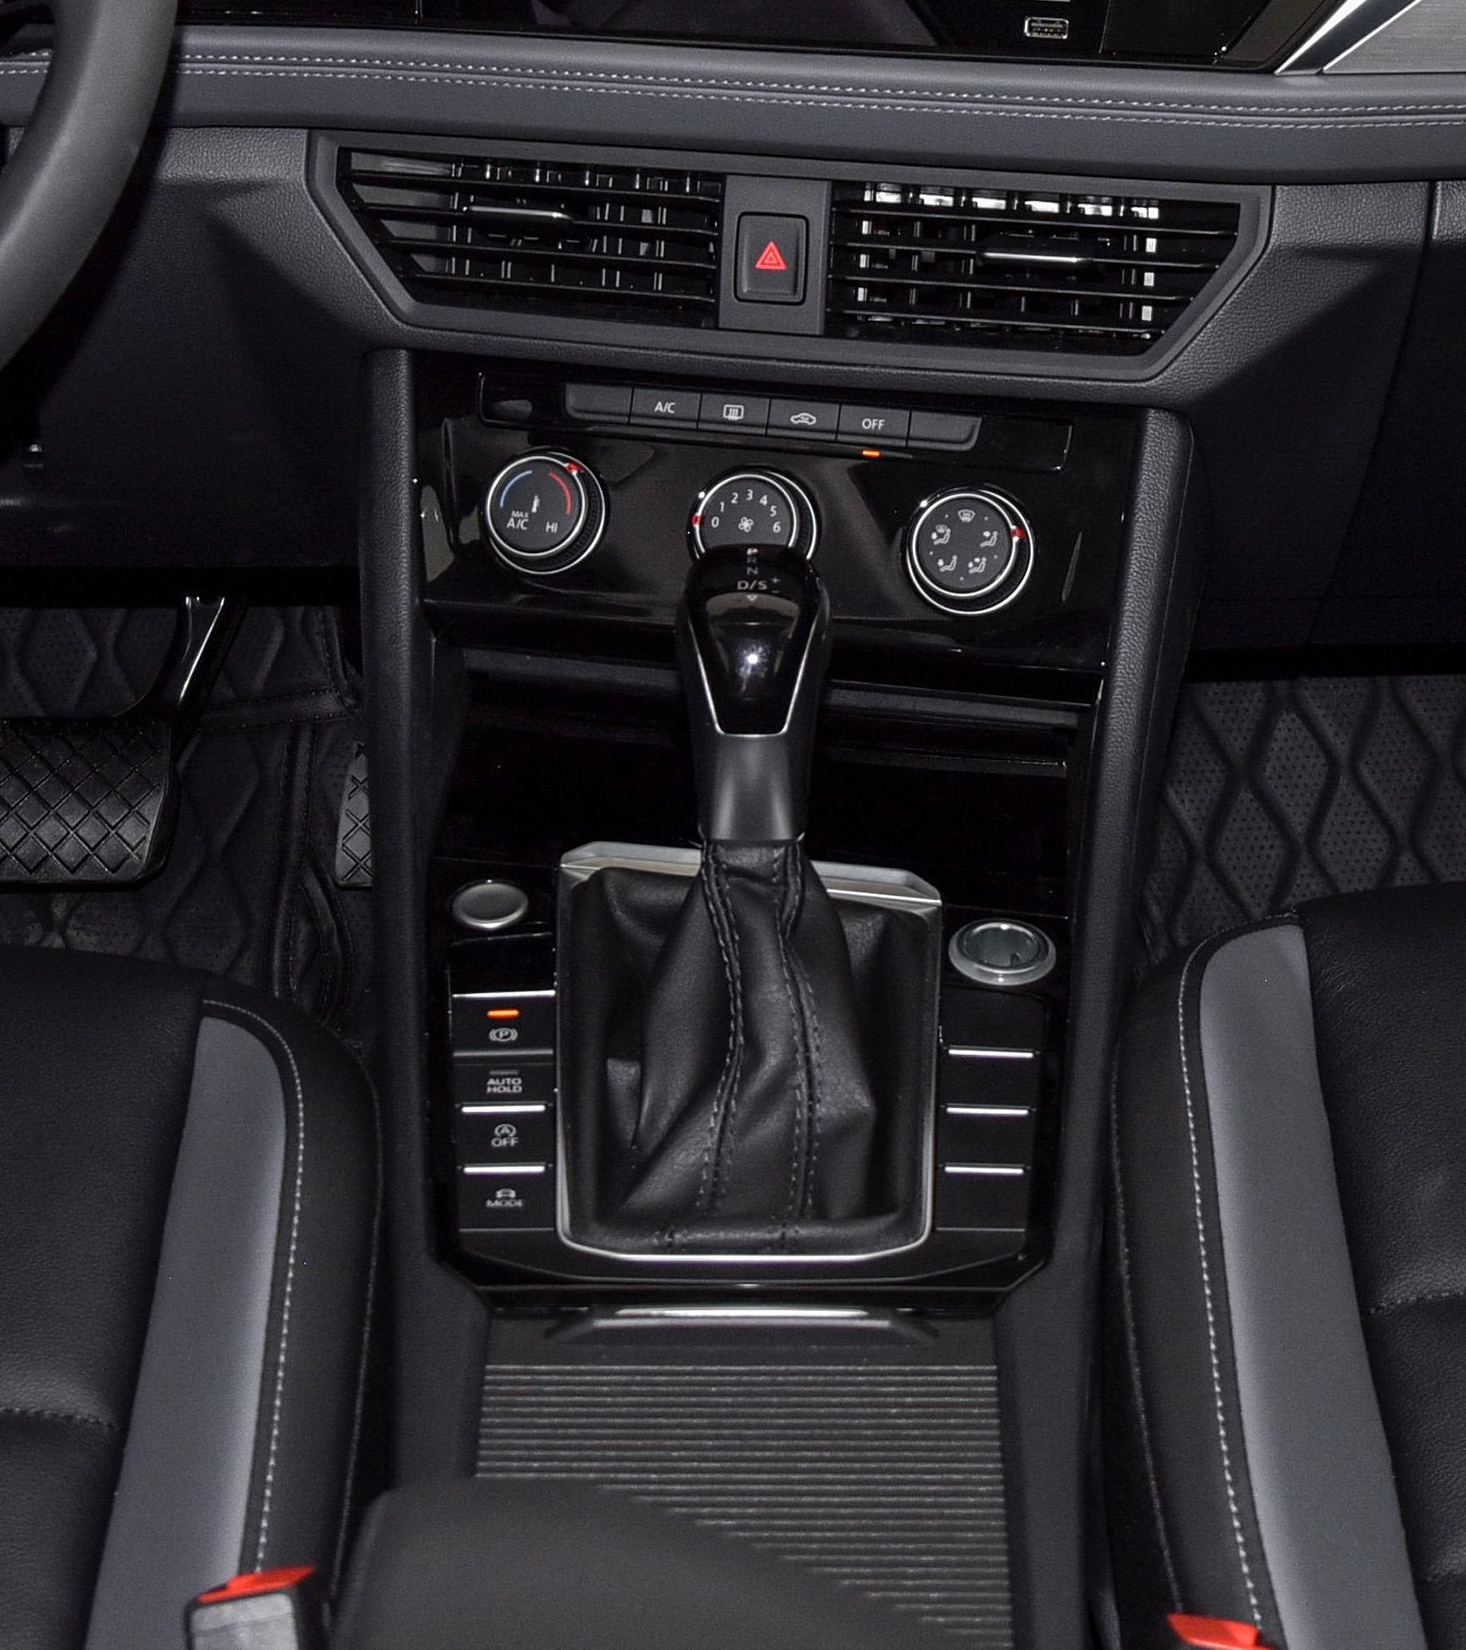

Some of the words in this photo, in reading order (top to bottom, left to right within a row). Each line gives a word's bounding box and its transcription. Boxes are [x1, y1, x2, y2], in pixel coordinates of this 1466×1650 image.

[654, 401, 676, 414] A/C
[861, 418, 885, 430] OFF
[731, 492, 739, 504] 2
[746, 489, 753, 501] 3
[759, 495, 768, 506] 4
[719, 501, 726, 513] 1
[770, 505, 777, 517] 5
[511, 510, 529, 518] MAX
[506, 517, 529, 530] A/C
[545, 521, 558, 533] HI
[711, 516, 719, 528] 0
[773, 521, 781, 533] 6
[737, 580, 768, 590] D/S
[486, 1077, 522, 1086] AUTO
[491, 1137, 519, 1147] OFF
